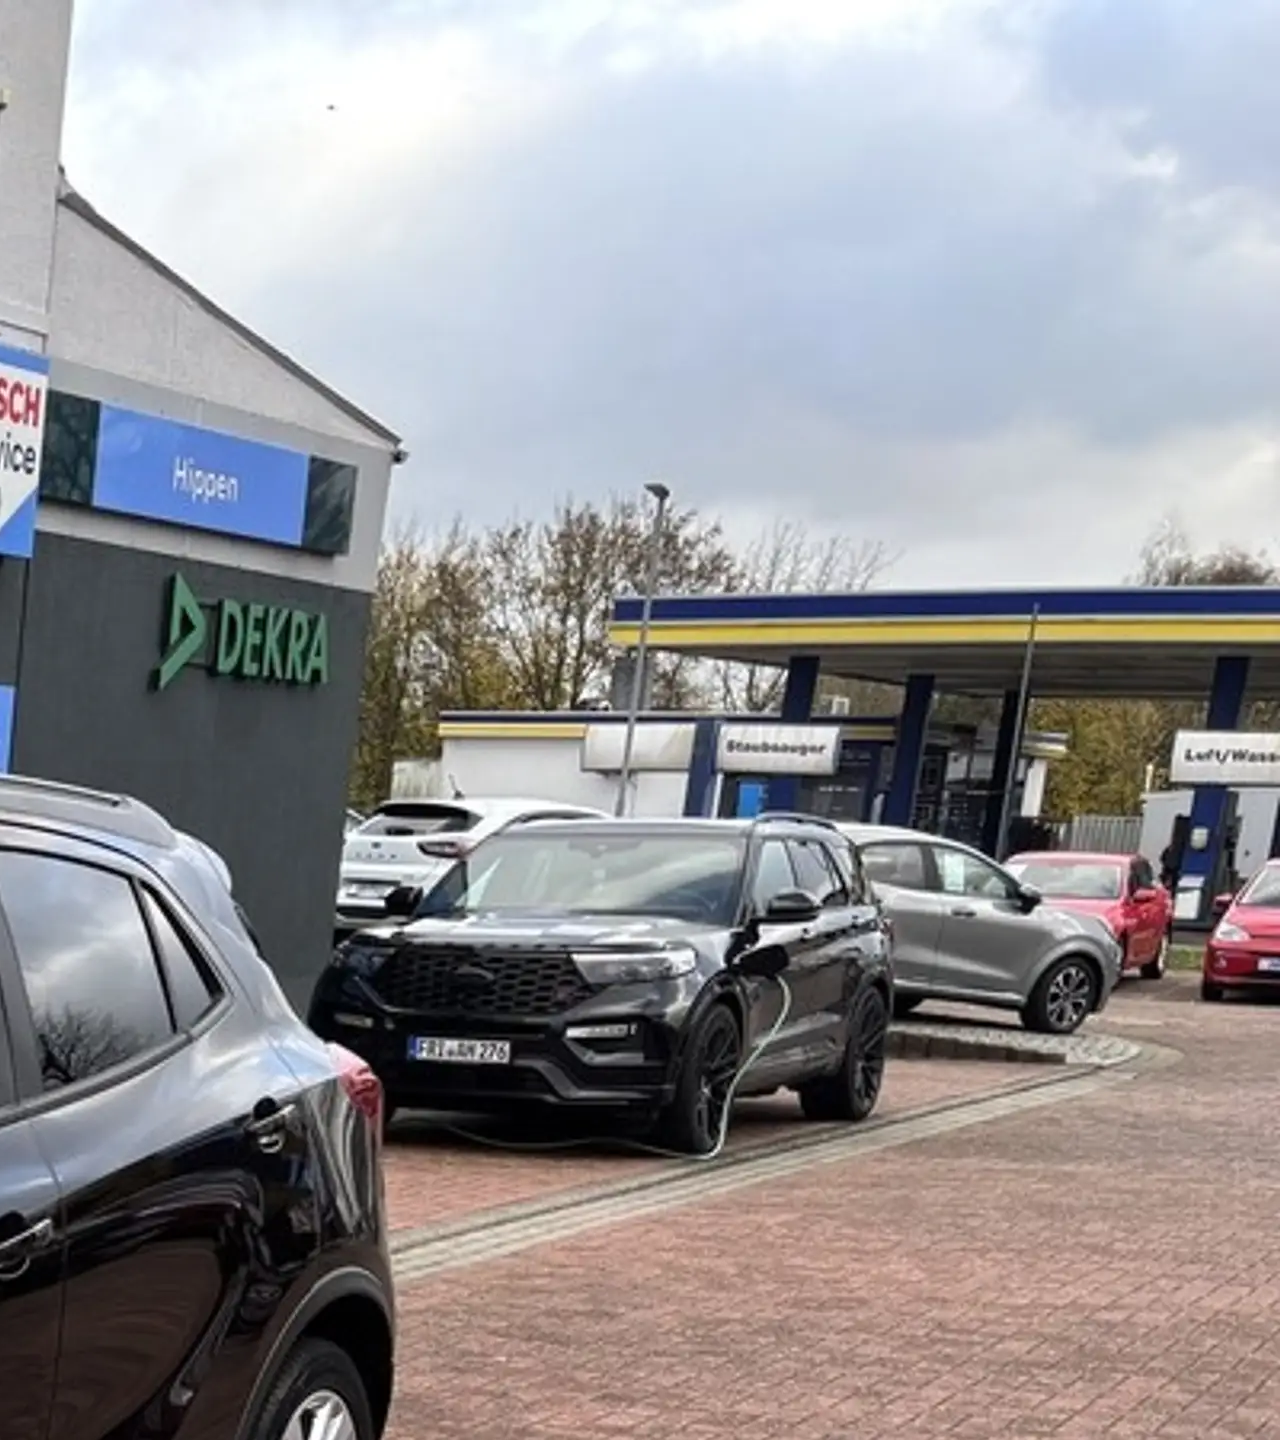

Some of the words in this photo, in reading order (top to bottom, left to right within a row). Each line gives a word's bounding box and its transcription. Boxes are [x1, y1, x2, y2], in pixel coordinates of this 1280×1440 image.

[171, 456, 239, 503] Hippen
[216, 598, 328, 684] DEKRA
[726, 739, 827, 757] Staubsauger
[1184, 748, 1280, 764] Luft/Wass
